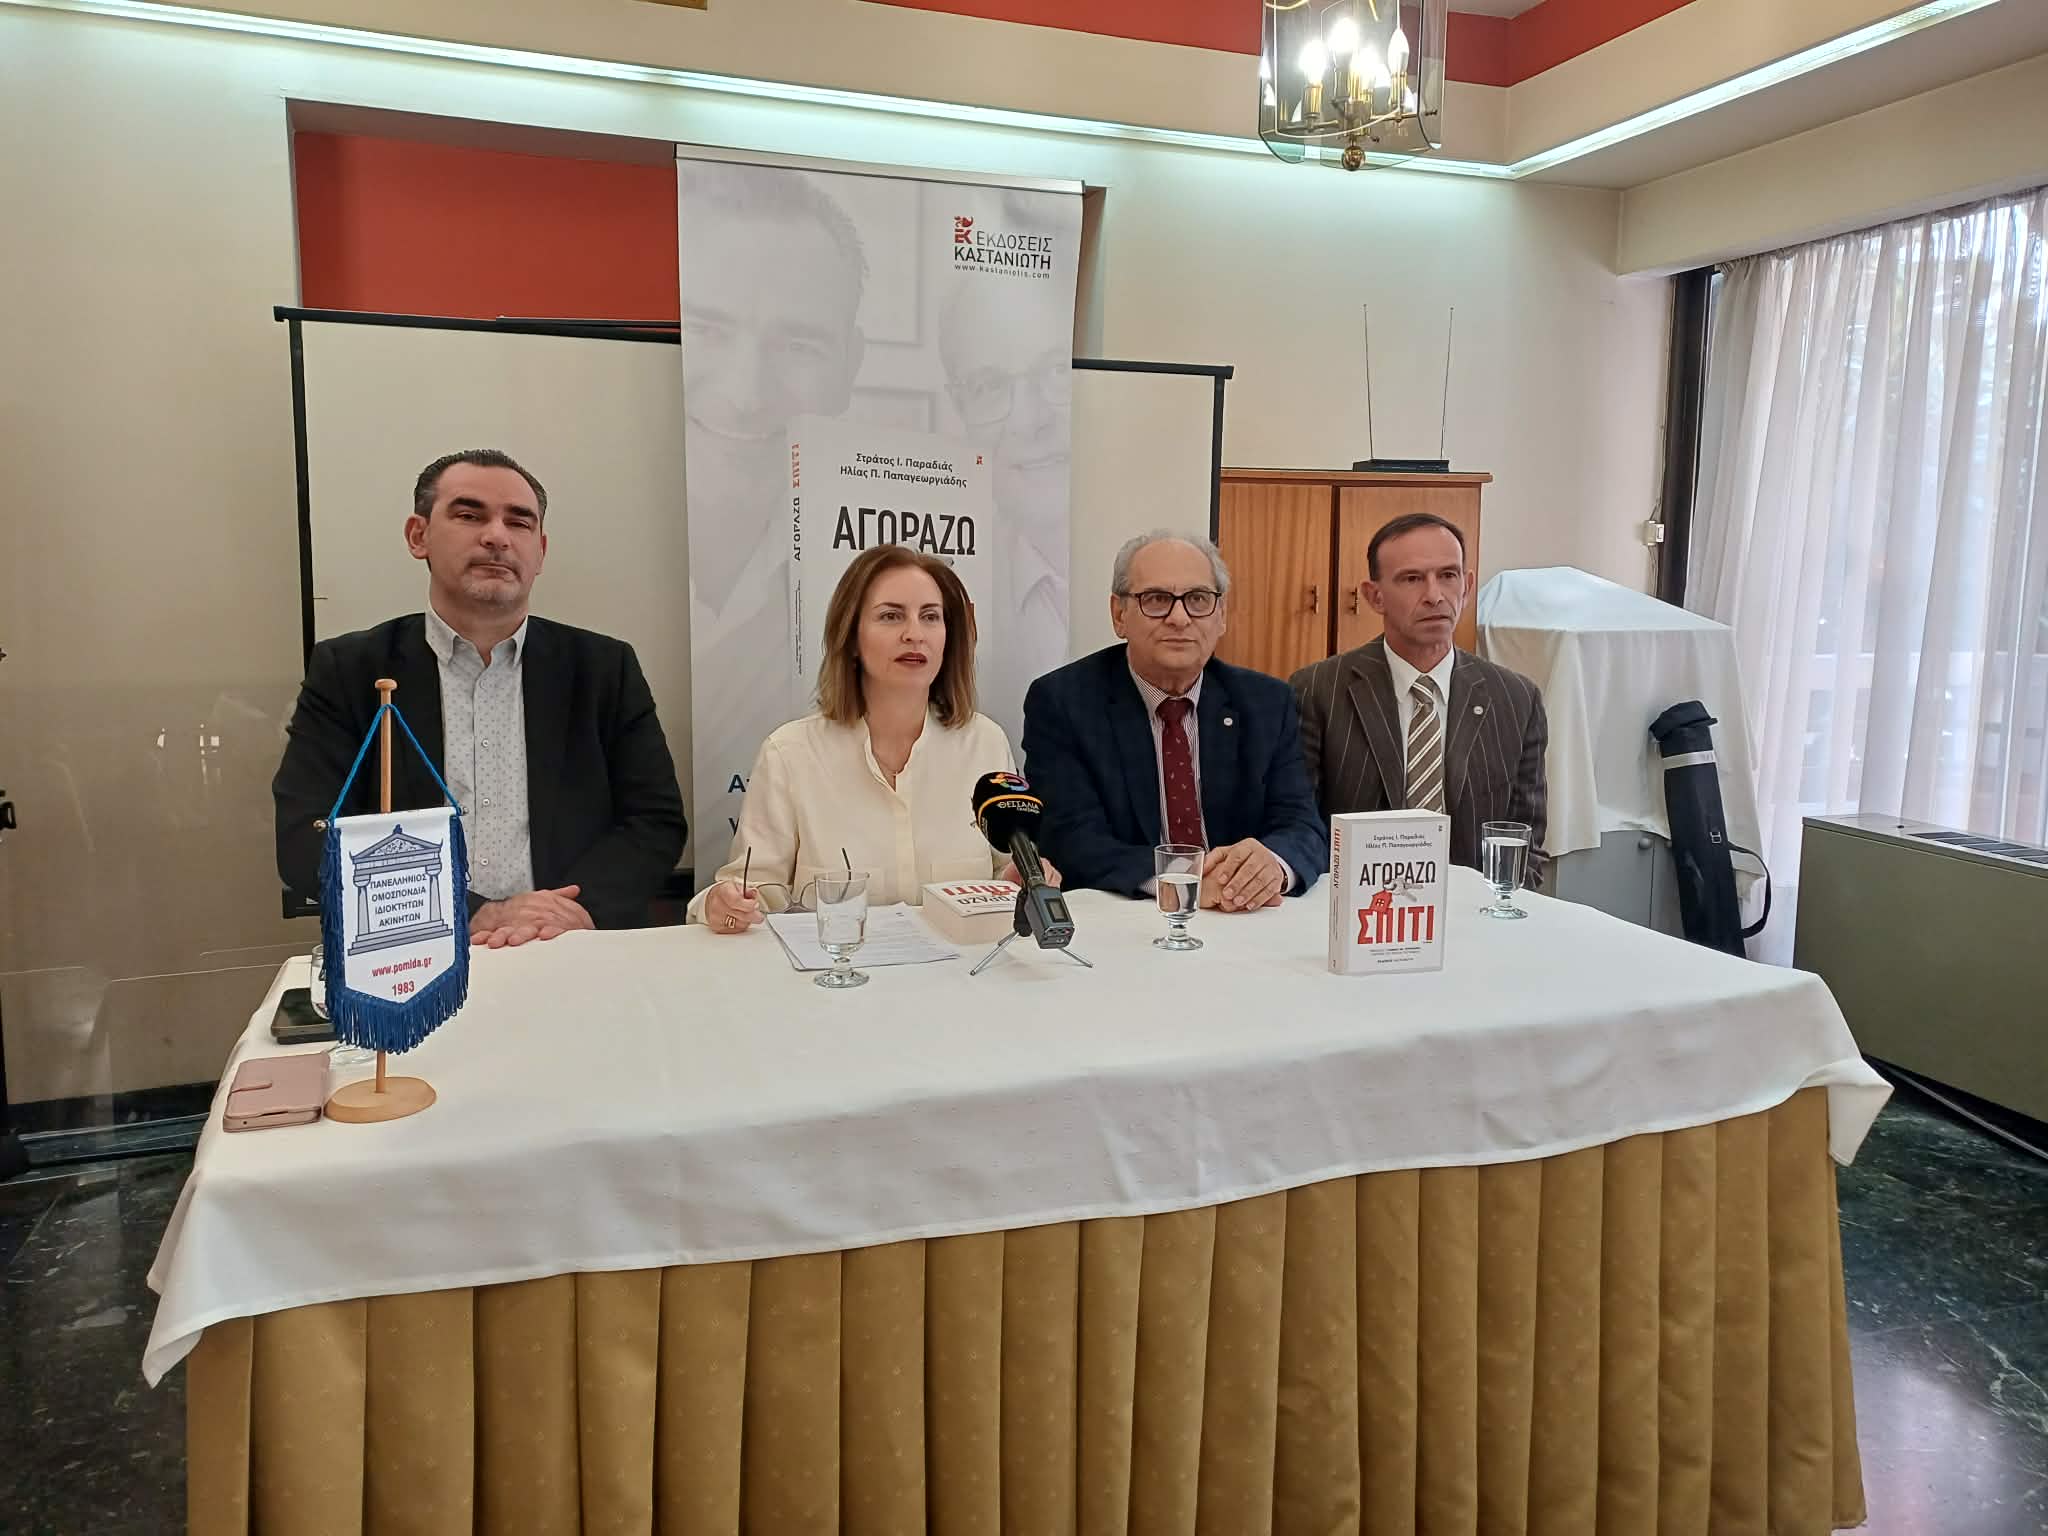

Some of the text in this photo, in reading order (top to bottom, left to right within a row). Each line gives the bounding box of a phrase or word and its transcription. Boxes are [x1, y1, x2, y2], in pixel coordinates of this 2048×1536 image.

[976, 230, 1053, 253] ΕΚΔΟΣΕΙΣ
[954, 245, 1051, 270] ΚΑΣΤΑΝΙΩΤΗ
[954, 264, 1050, 279] www.kastaniotis.com
[856, 453, 895, 467] Στράτος
[905, 458, 953, 472] Παραδιάς
[840, 465, 967, 488] Ηλίας Π. Παπαγεωργιάδης
[792, 497, 801, 561] ΑΓΟΡΑΖΩ
[832, 506, 976, 556] ΑΓΟΡΑΖΩ
[370, 873, 428, 890] ΠΑΝΕΛΛΗΝΙΟΣ
[1359, 861, 1436, 887] ΑΓΟΡΑΖΩ
[371, 886, 427, 902] ΟΜΟΣΠΟΝΔΙΑ
[375, 899, 424, 915] ΙΔΙΟΚΤΗΤΩΝ
[379, 912, 421, 928] ΑΚΙΝΗΤΩΝ
[1357, 905, 1435, 945] ΣΠΙΤΙ
[371, 956, 433, 978] www.pomida.gr
[391, 980, 415, 997] 1983
